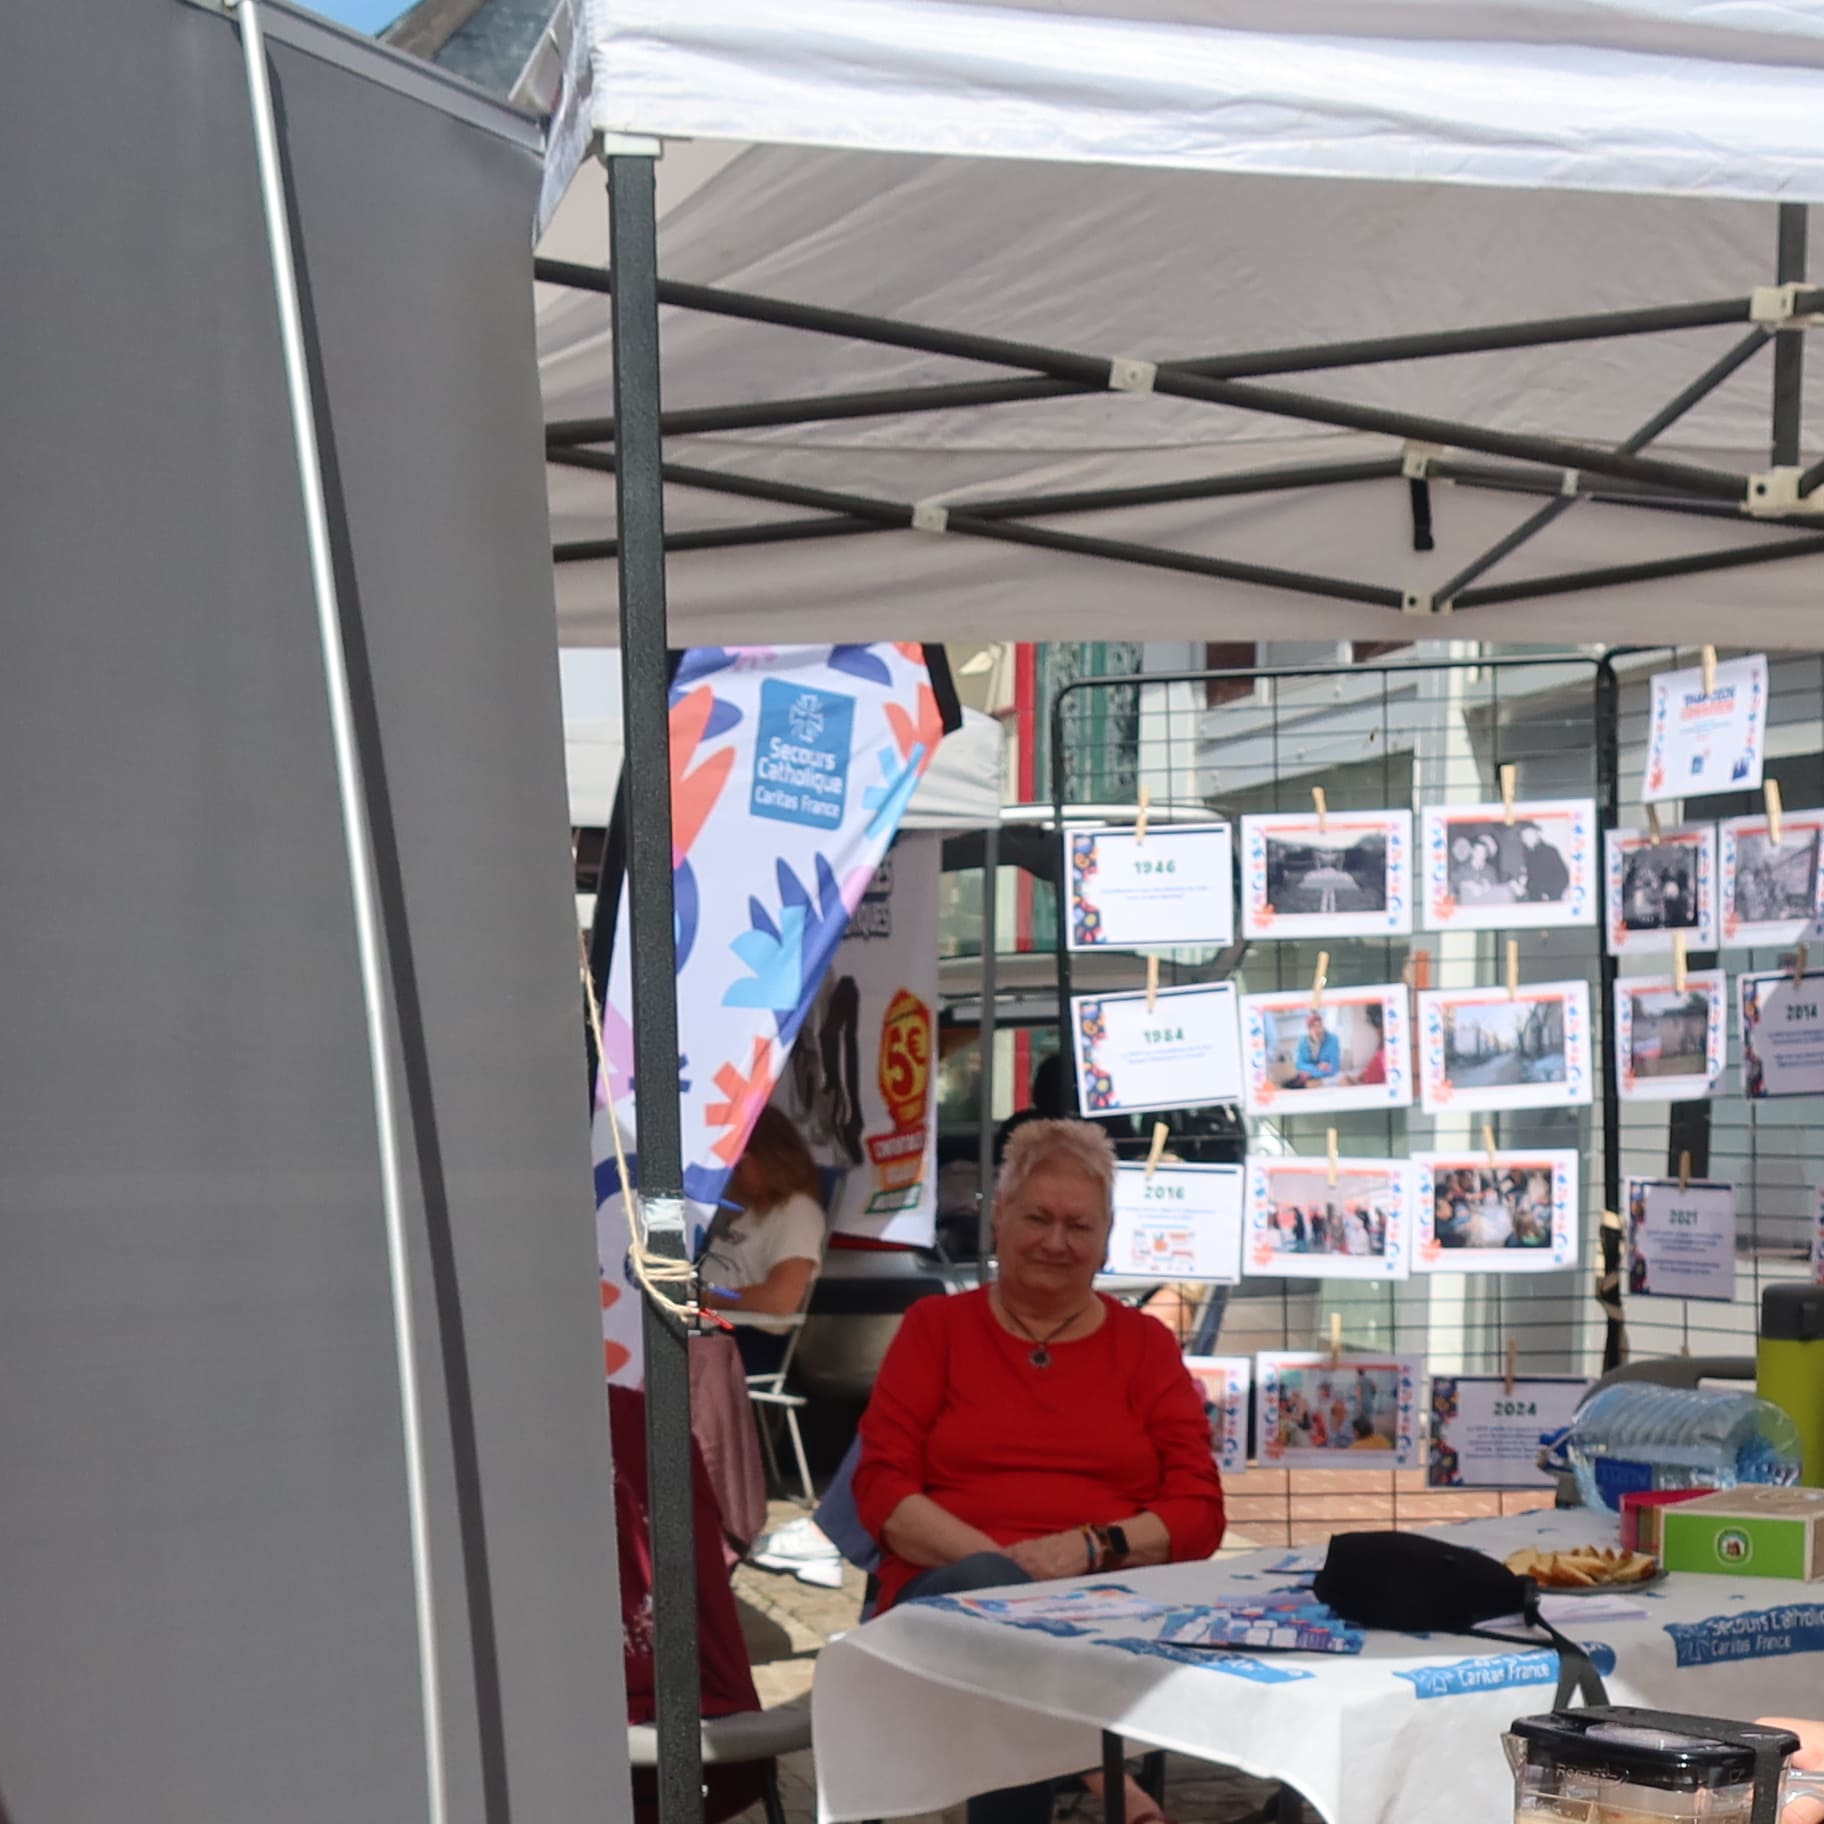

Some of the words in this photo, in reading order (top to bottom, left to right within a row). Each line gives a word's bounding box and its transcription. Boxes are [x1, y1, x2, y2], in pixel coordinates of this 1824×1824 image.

[768, 736, 836, 771] Secours
[757, 757, 843, 795] Catholique
[754, 785, 799, 811] Caritas
[800, 795, 841, 819] France
[1134, 860, 1176, 874] 1946
[1143, 1028, 1185, 1043] 1984
[1144, 1185, 1186, 1200] 2016
[1494, 1402, 1538, 1416] 2024
[1706, 1613, 1769, 1637] Secours
[1754, 1633, 1792, 1651] France
[1456, 1666, 1505, 1688] Caritas
[1507, 1661, 1551, 1681] France
